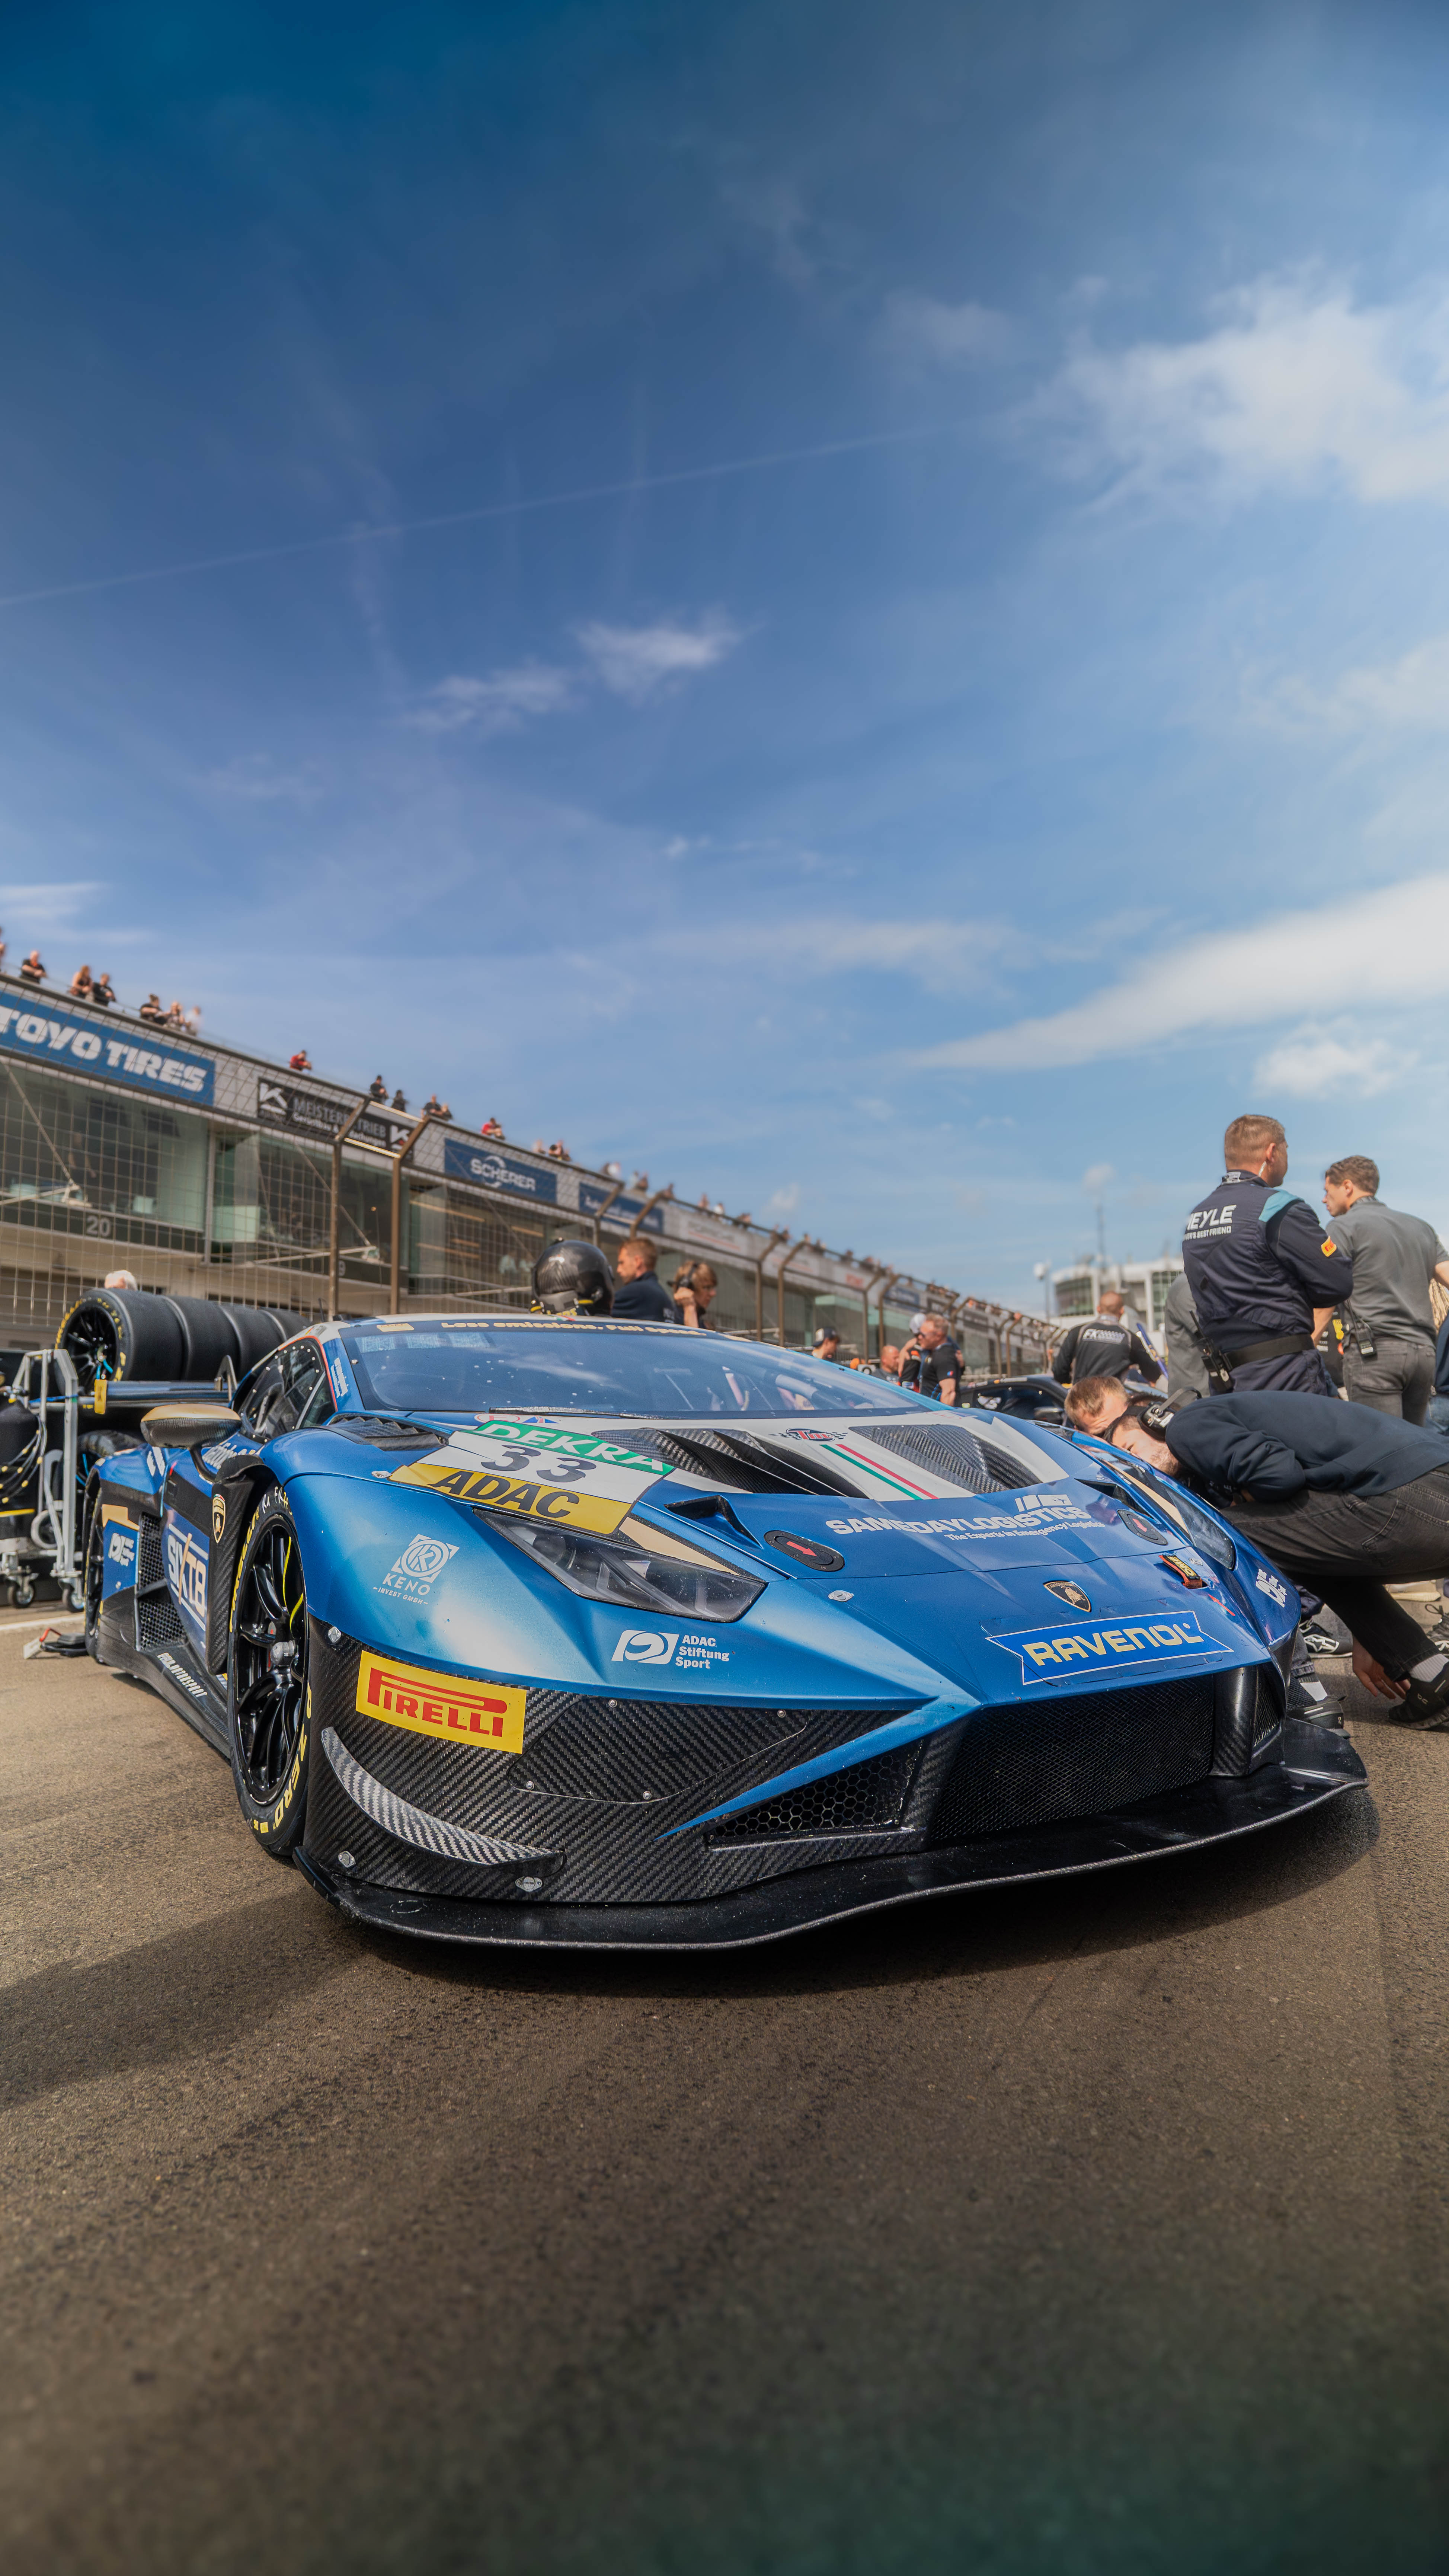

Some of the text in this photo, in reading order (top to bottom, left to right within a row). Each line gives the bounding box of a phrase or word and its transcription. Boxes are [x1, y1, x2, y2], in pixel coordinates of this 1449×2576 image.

[0, 1007, 207, 1092] TOYO TIRES
[470, 1157, 535, 1191] SCHERER
[87, 1215, 111, 1236] 20
[1187, 1205, 1237, 1230] EYLE
[1209, 1225, 1232, 1236] FRIEND
[474, 1423, 664, 1472] DEKRA
[481, 1445, 597, 1483] 33
[428, 1471, 579, 1518] ADAC
[825, 1506, 1091, 1534] SAMEDAYLOGISTICS
[1013, 1521, 1068, 1537] Emergency
[1065, 1521, 1106, 1530] Logistics
[378, 1587, 423, 1604] INVEST GMBH
[383, 1573, 430, 1596] KENO
[682, 1635, 716, 1647] ADAC
[1022, 1623, 1205, 1666] RAVENOL
[675, 1656, 710, 1669] Sport
[679, 1647, 730, 1661] Stiftung
[367, 1667, 507, 1737] PIRELLI
